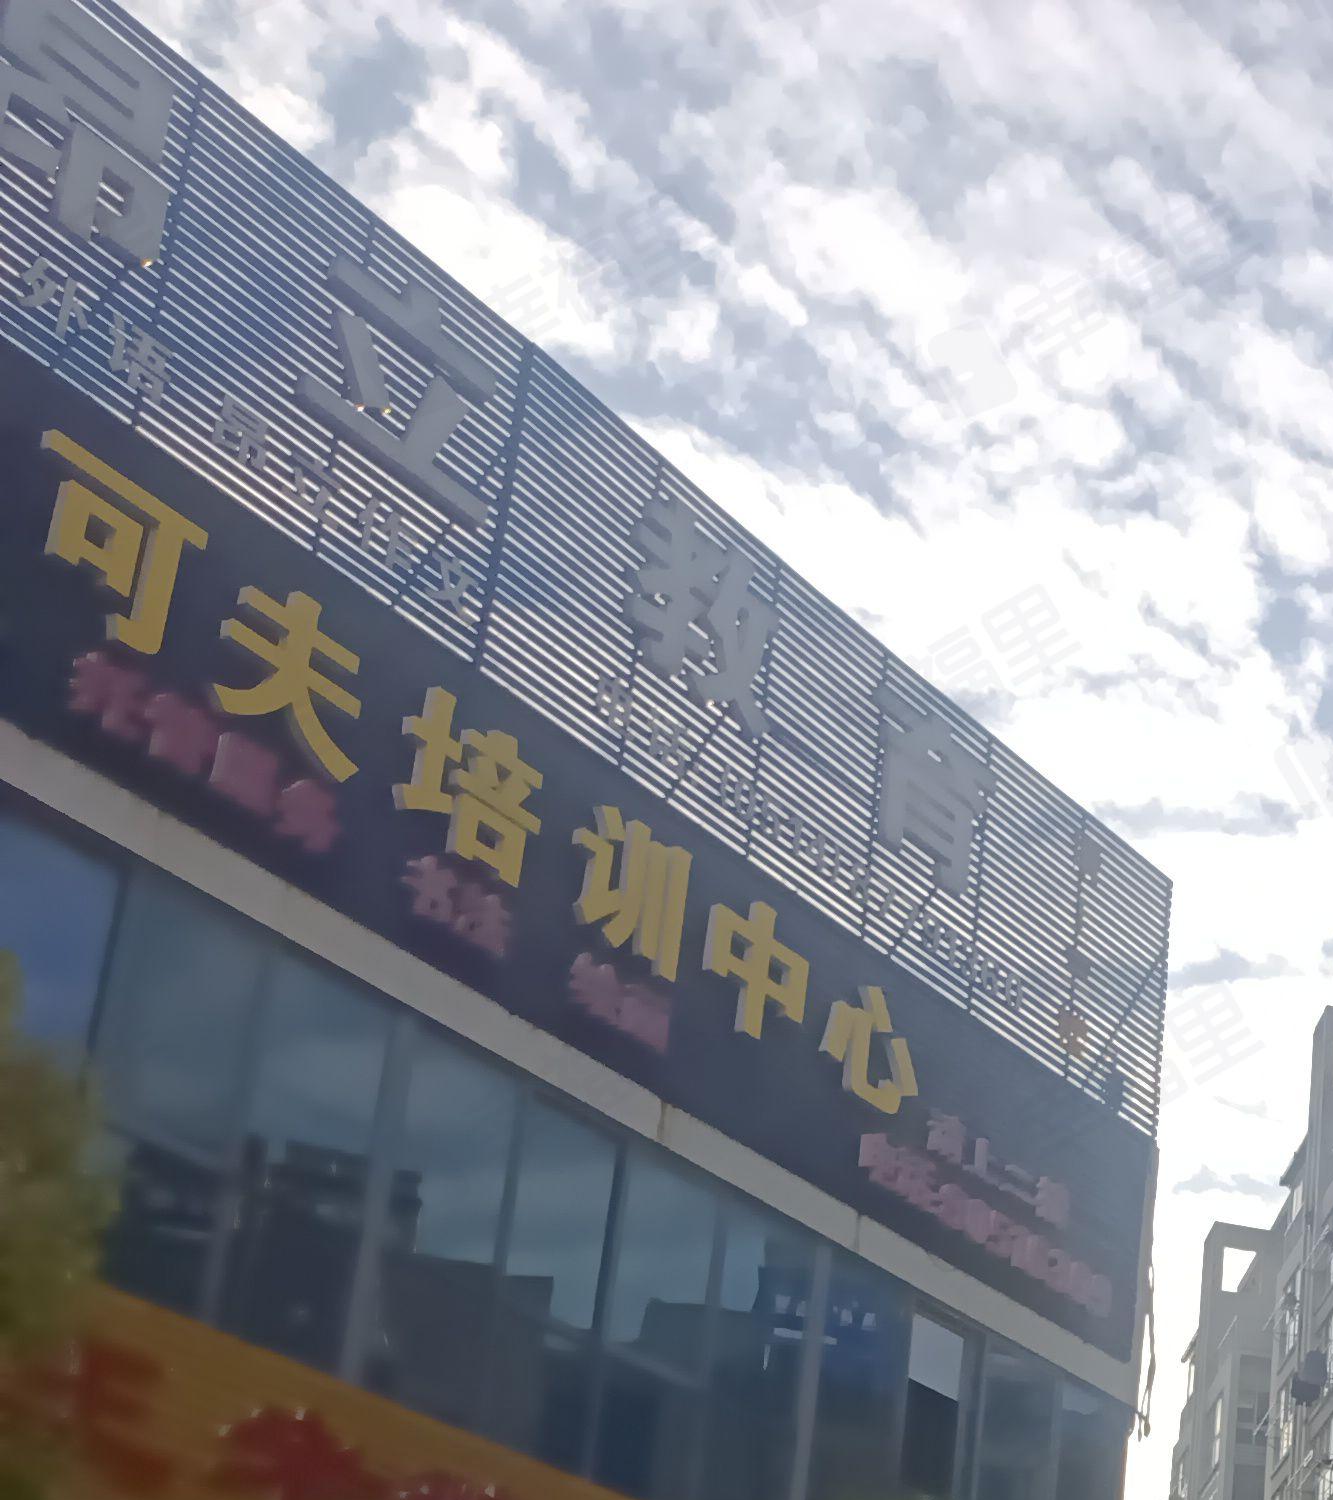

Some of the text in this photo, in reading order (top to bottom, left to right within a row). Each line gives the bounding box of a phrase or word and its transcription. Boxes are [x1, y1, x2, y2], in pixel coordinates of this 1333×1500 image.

[41, 428, 918, 1115] 可夫培训中心
